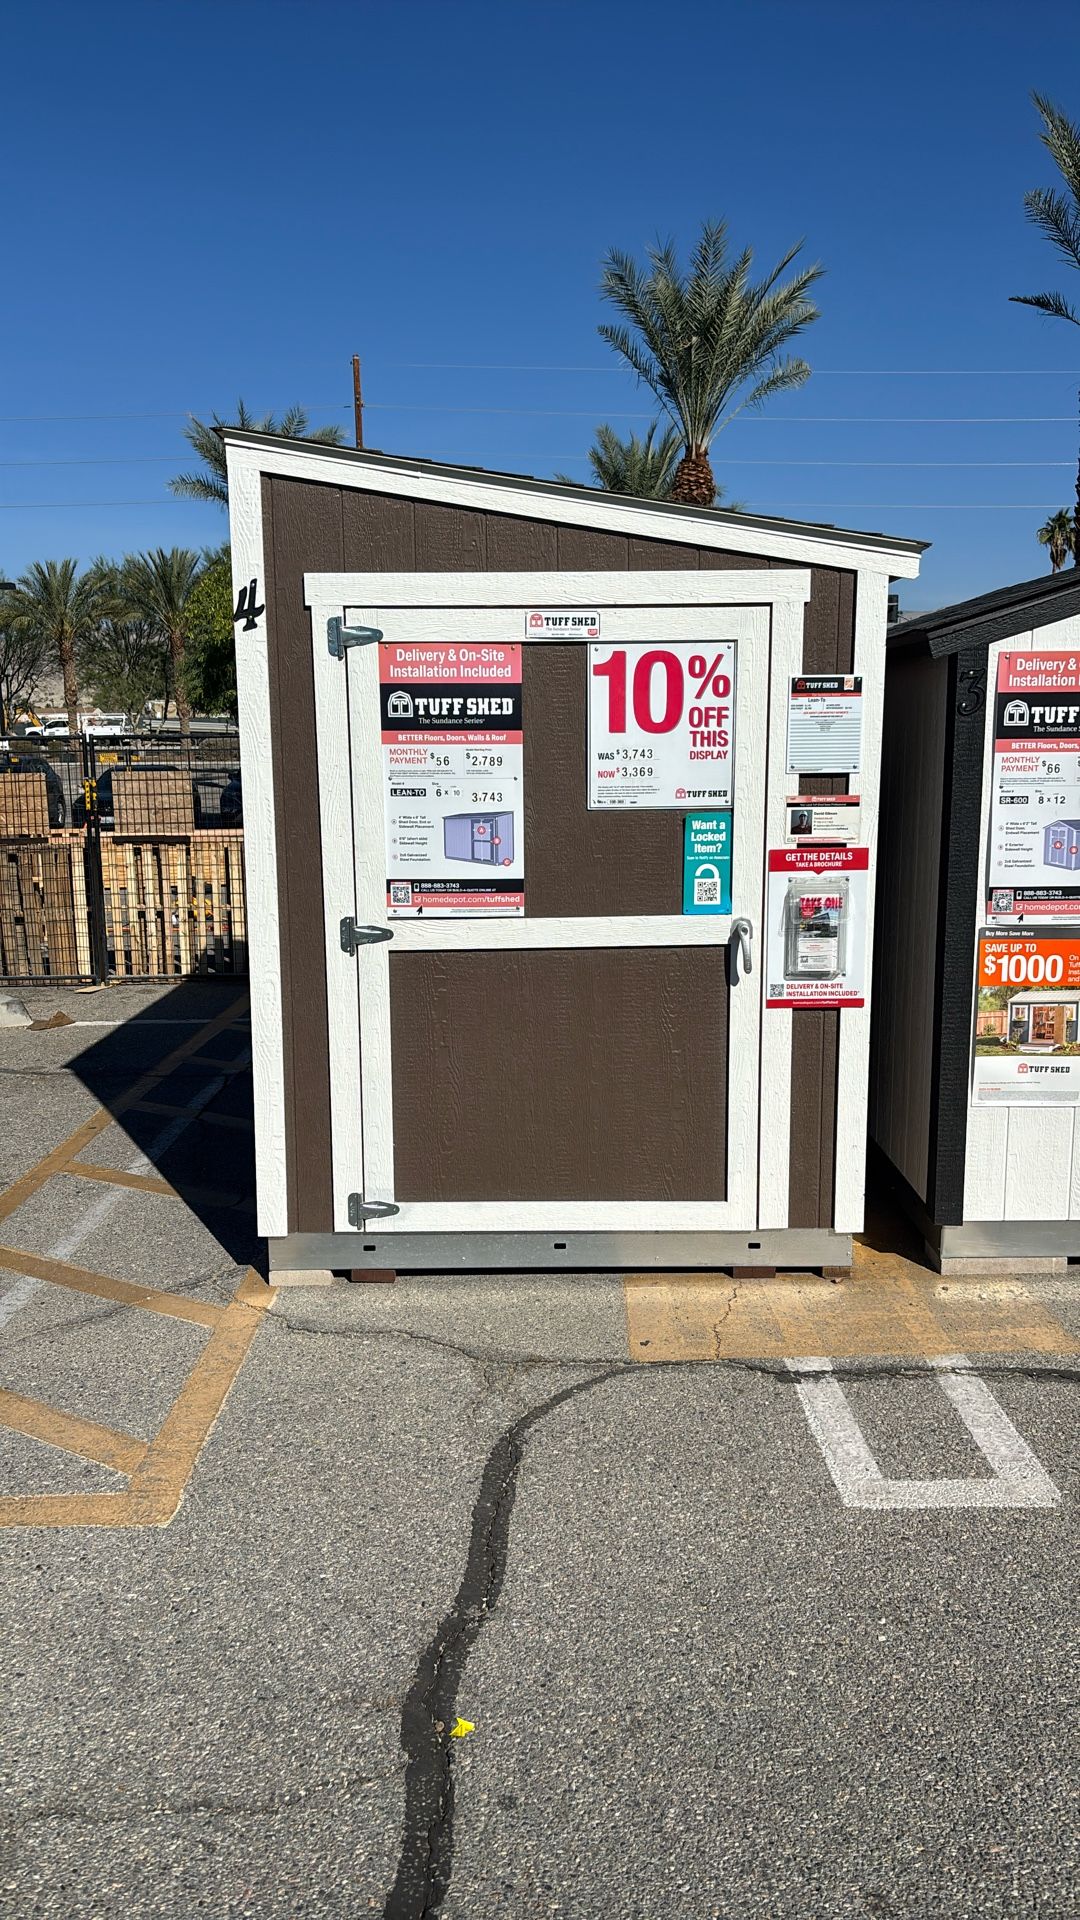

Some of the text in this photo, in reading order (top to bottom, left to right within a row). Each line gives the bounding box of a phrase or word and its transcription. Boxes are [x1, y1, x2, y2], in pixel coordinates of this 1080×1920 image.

[232, 577, 265, 632] 4
[544, 617, 596, 626] TUFF SHED
[396, 649, 505, 663] Delivery & On-Site
[1016, 658, 1077, 673] Delivery &
[389, 665, 511, 677] Installation Included
[1009, 674, 1076, 686] Installation
[593, 650, 731, 734] 10%
[957, 668, 985, 716] 3
[414, 698, 513, 715] TUFF SHED
[688, 706, 729, 728] OFF
[1031, 706, 1080, 724] TUFF
[424, 734, 445, 742] Floors,
[446, 734, 467, 742] Doors,
[689, 730, 729, 747] THIS
[1037, 742, 1058, 750] Floors,
[389, 748, 428, 756] MONTHLY
[689, 750, 728, 760] DISPLAY
[391, 788, 426, 796] LEAN-TO
[436, 789, 442, 797] 6
[687, 790, 707, 798] TUFF
[471, 792, 503, 803] 3,743
[1001, 796, 1028, 804] SR-600
[1038, 796, 1044, 804] 8
[1054, 796, 1066, 804] 12
[692, 820, 717, 830] Want
[690, 831, 726, 841] Locked
[694, 843, 722, 853] Item?
[785, 852, 853, 861] GET THE DETAILS
[824, 897, 843, 909] ONE
[1024, 903, 1080, 911] homedepot.co
[985, 944, 1037, 953] SAVE UP TO
[984, 954, 1064, 983] $1000
